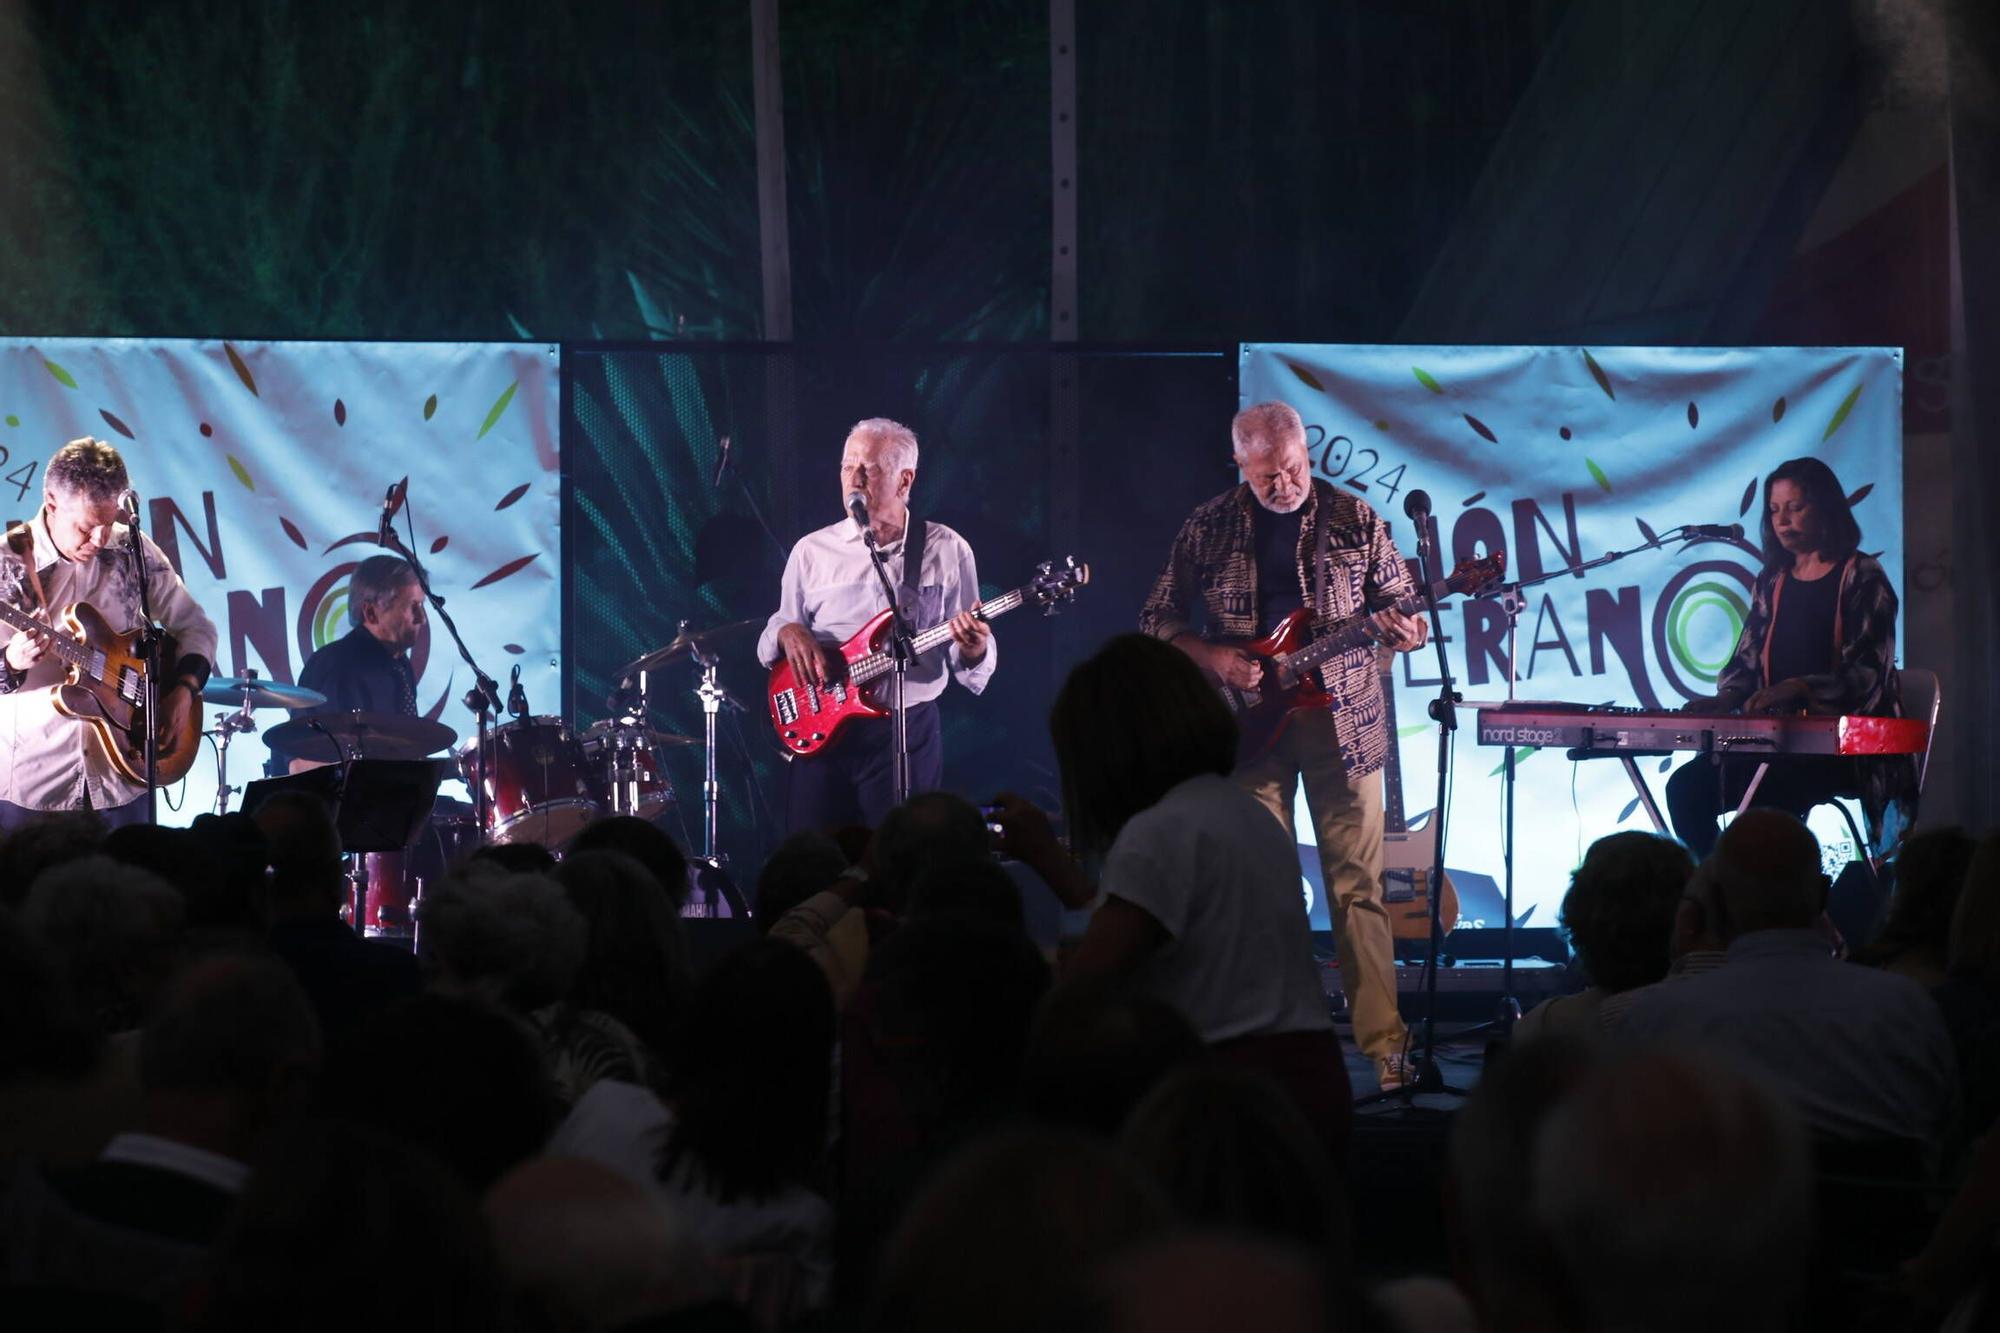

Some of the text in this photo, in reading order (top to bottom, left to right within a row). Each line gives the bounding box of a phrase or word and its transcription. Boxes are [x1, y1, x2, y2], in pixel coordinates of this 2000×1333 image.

[1306, 425, 1407, 504] 2024
[1483, 727, 1514, 742] nord
[1517, 727, 1554, 745] stage
